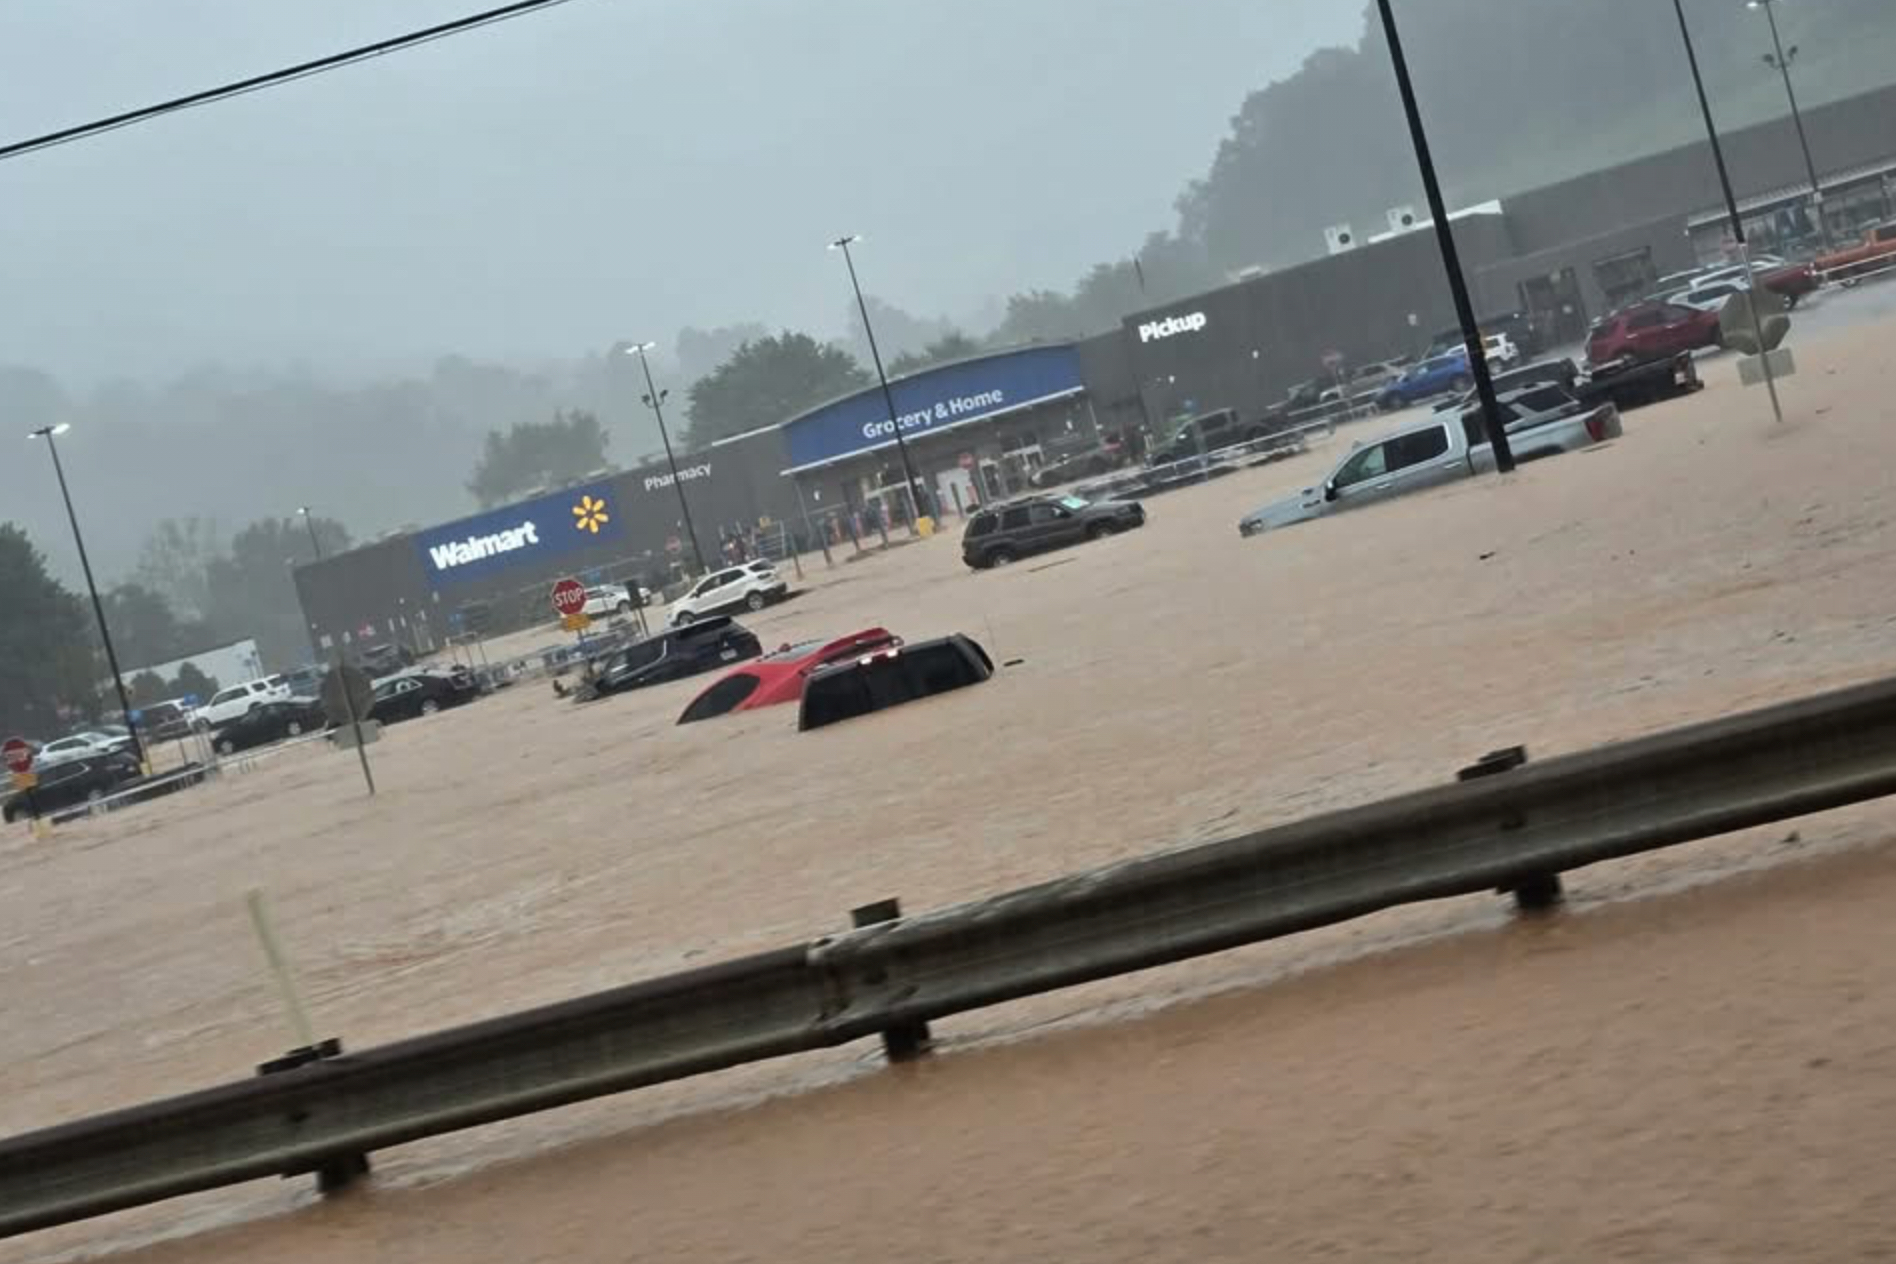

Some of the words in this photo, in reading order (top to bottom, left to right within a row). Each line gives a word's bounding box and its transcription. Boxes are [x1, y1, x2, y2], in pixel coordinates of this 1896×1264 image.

[1138, 311, 1206, 343] Pickup
[862, 408, 932, 439] Grocery
[934, 403, 949, 419] &
[949, 389, 1003, 415] Home
[644, 462, 711, 492] Pharmacy
[429, 521, 539, 571] Walmart
[555, 587, 583, 607] STOP
